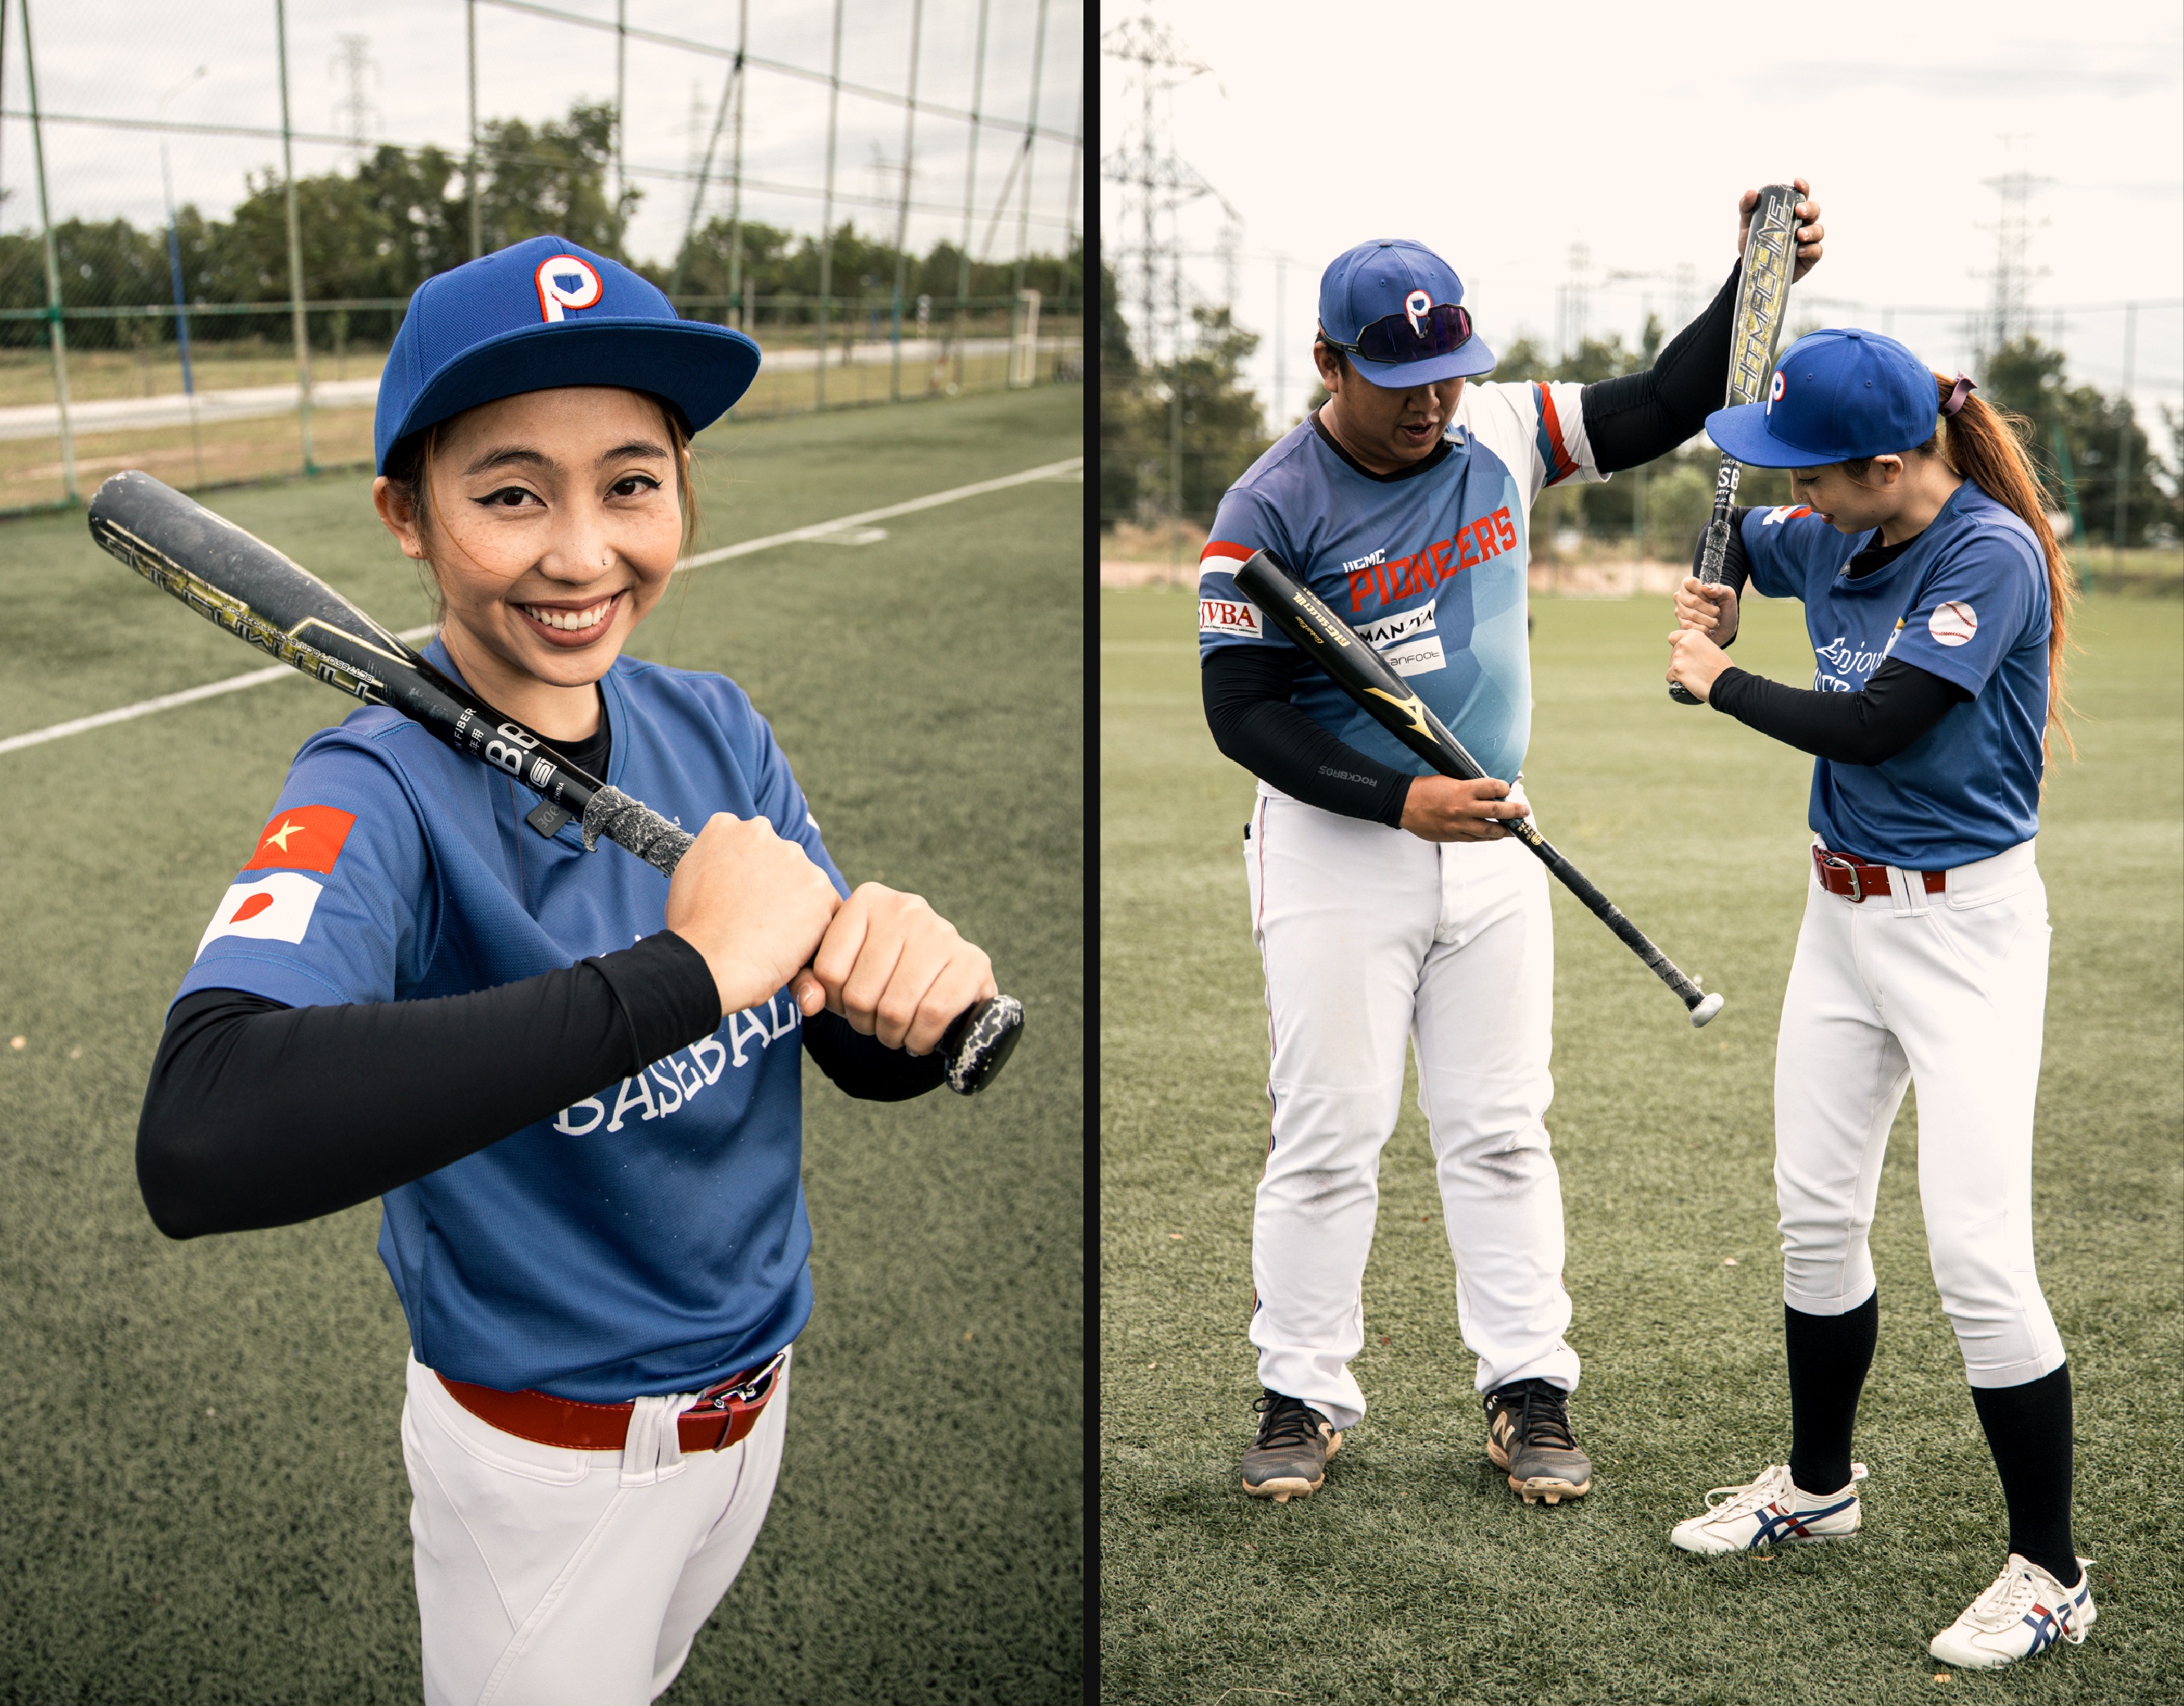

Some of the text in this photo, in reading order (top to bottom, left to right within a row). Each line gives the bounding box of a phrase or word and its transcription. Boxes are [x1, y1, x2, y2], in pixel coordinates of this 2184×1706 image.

[1342, 547, 1386, 574] HCMC
[1346, 505, 1517, 613] PIONEERS
[1201, 601, 1258, 629] JVBA
[454, 708, 477, 740] FIBER
[1319, 766, 1377, 788] ROCKBROS
[553, 995, 802, 1136] BASEBAL
